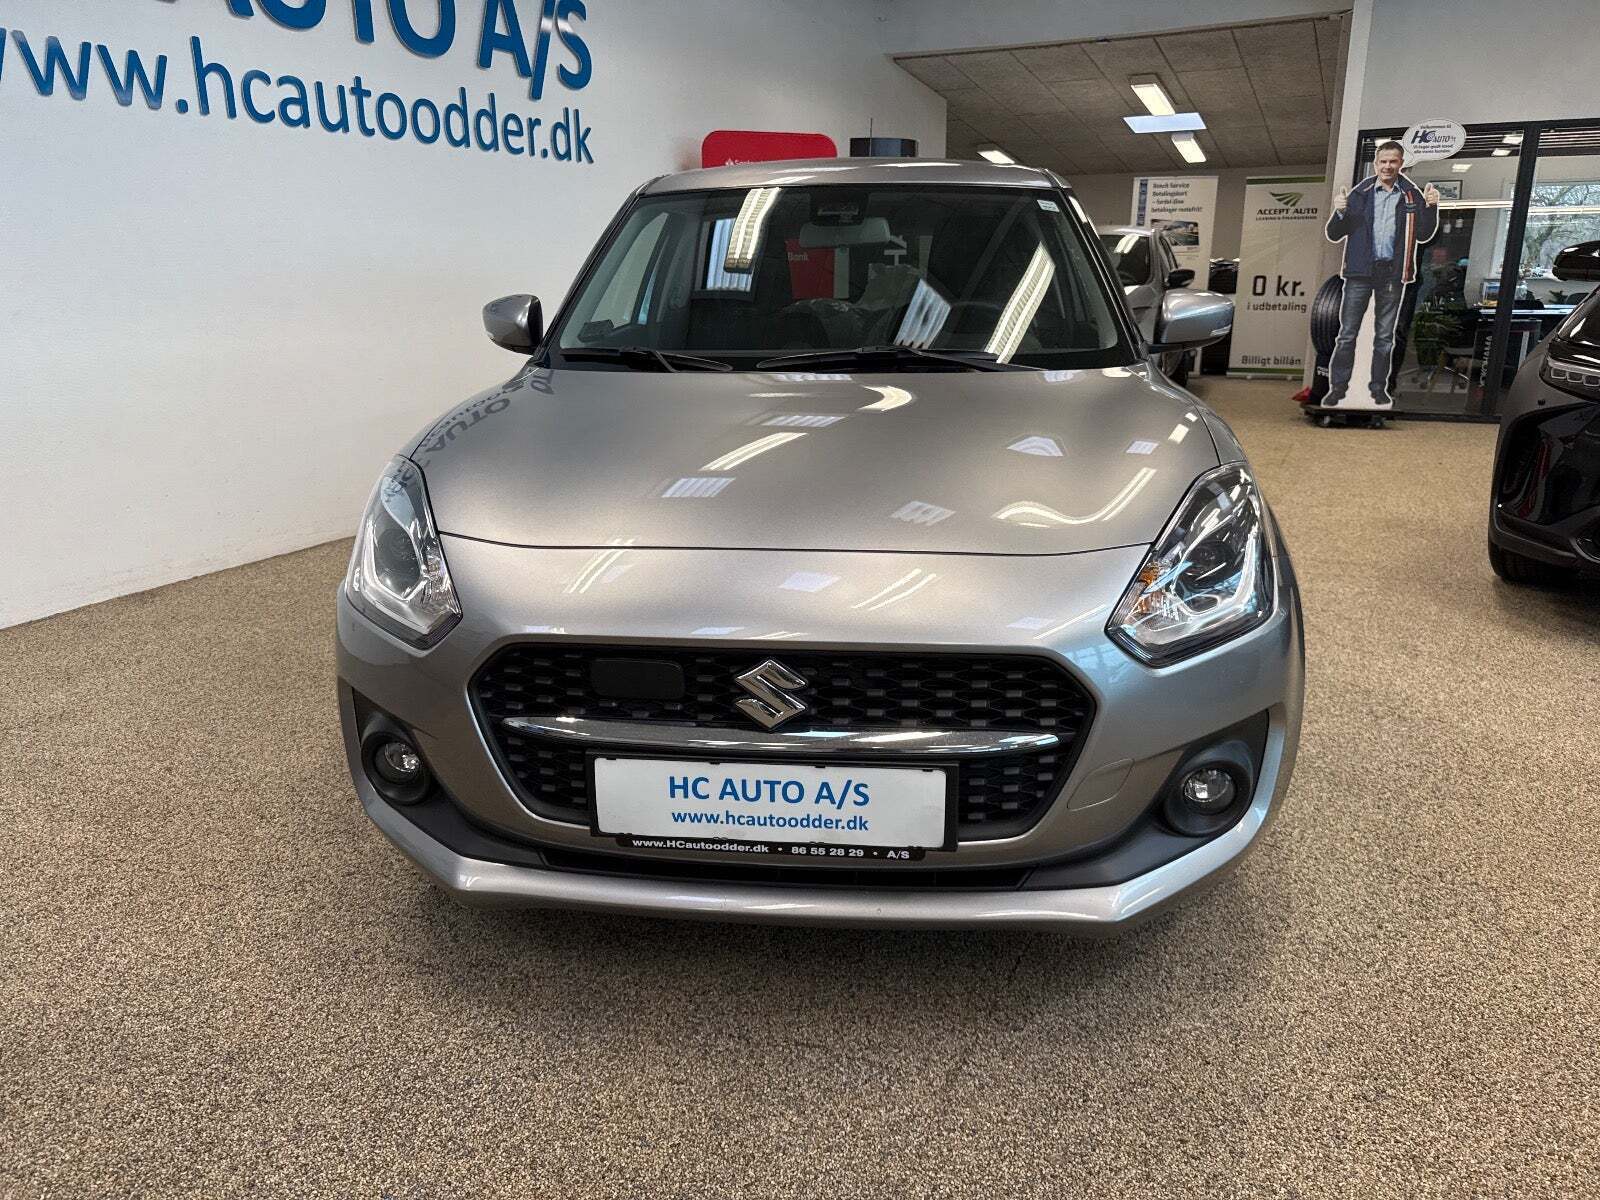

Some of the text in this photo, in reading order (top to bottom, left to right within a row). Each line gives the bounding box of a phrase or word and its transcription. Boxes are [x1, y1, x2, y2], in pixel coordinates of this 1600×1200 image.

[0, 27, 594, 164] ww.hcautoodder.dk
[1252, 275, 1305, 297] 0 kr.
[1247, 301, 1307, 313] i udbetaling
[1241, 354, 1301, 367] Billigt billån
[669, 775, 870, 810] HC AUTO A/S
[671, 810, 869, 831] www.hcautoodder.dk
[632, 839, 910, 860] www.HCautoodder.dk 86 55 28 29 A/S
